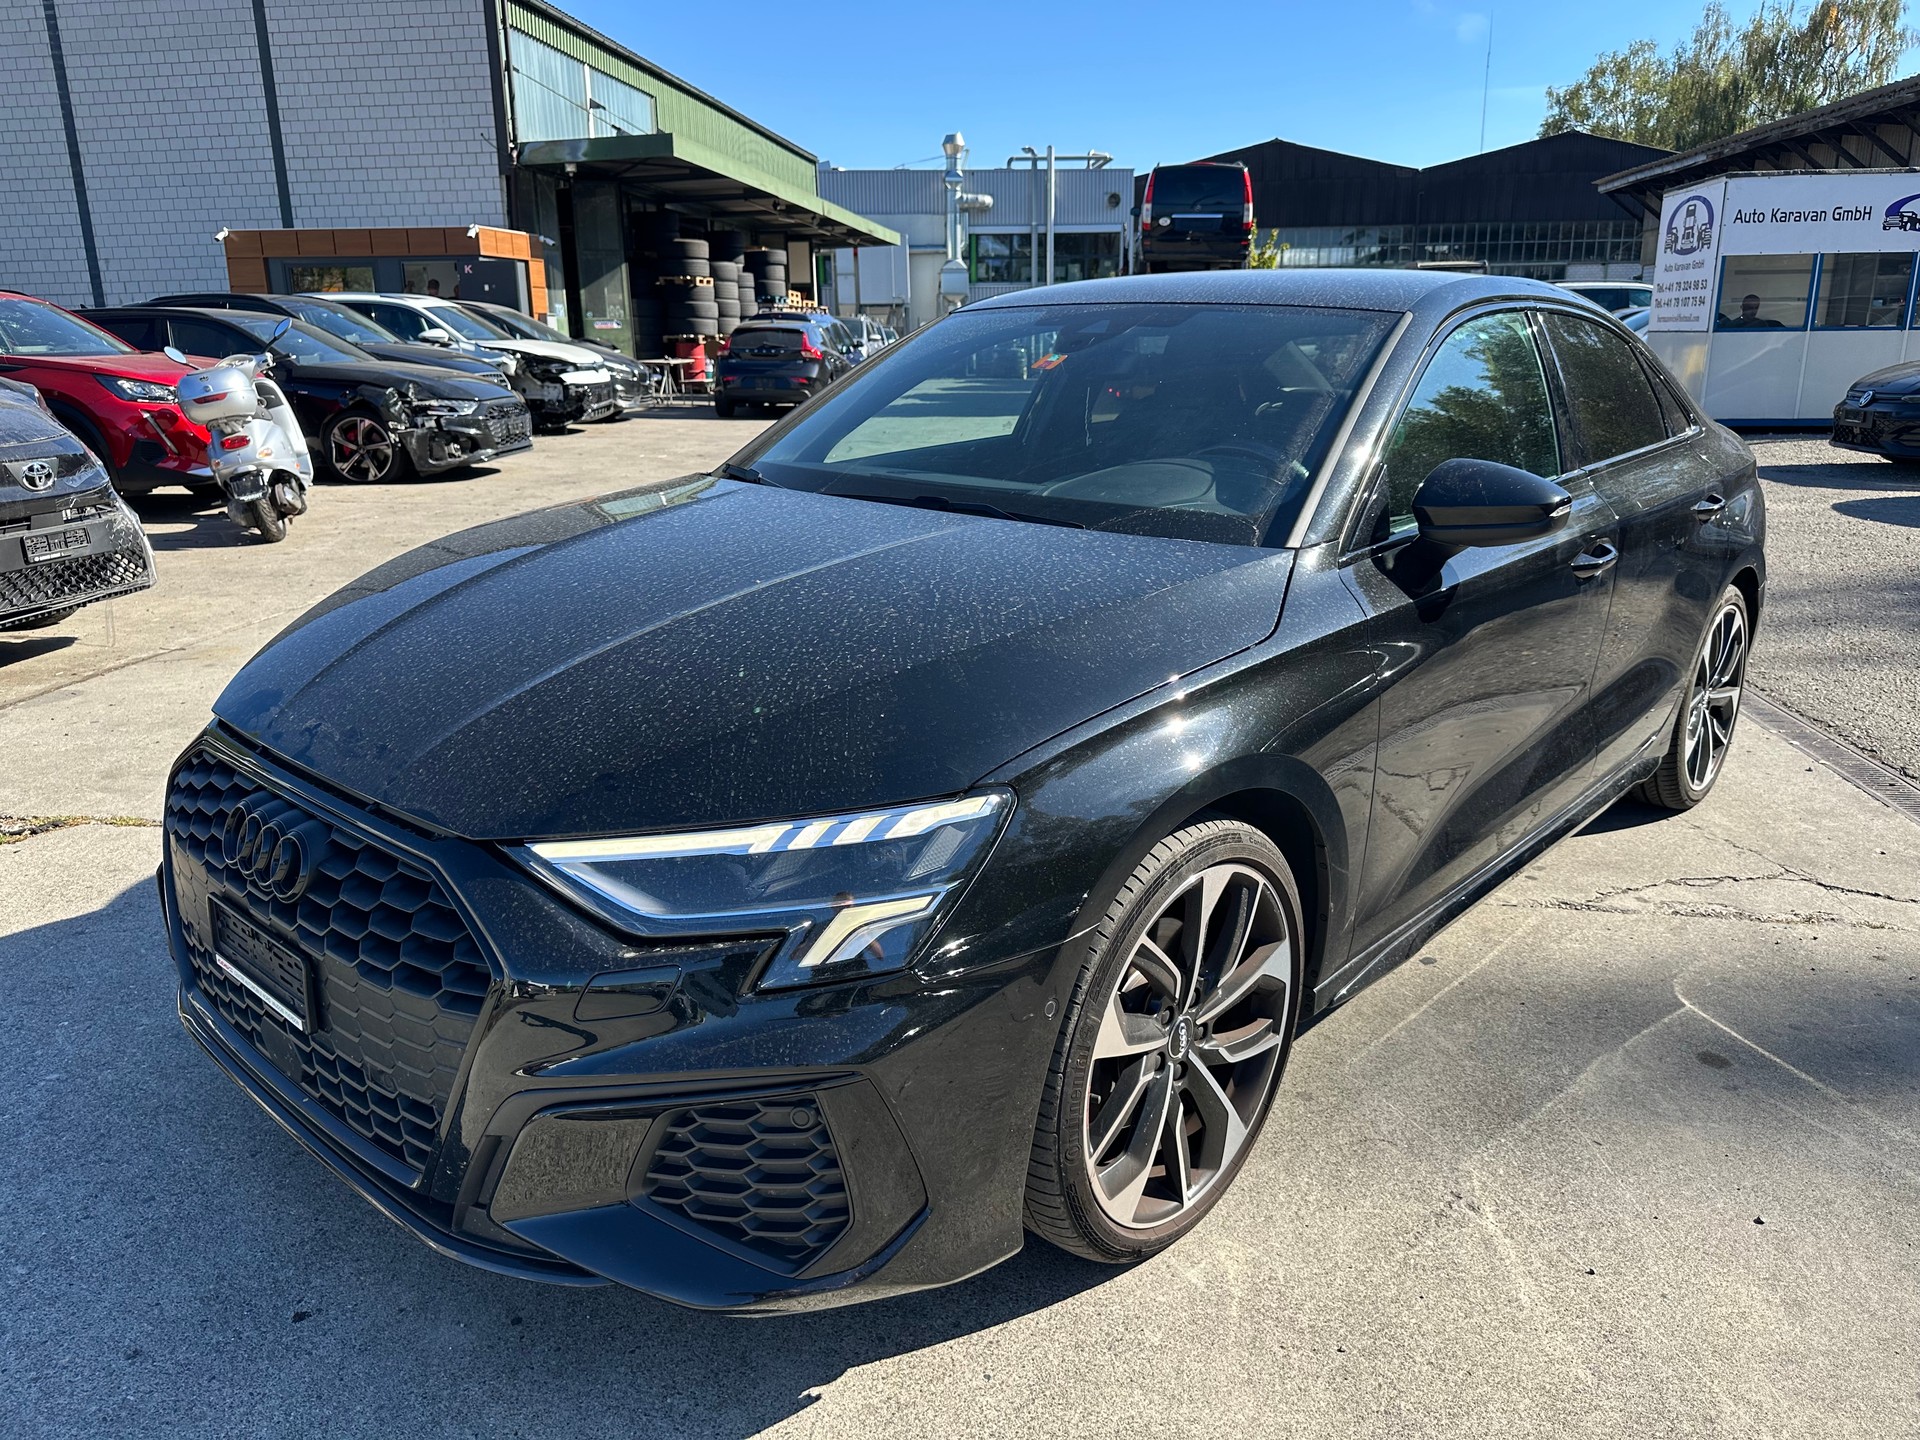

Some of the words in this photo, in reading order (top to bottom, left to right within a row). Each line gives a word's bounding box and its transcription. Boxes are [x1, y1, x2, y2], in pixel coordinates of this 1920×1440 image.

[1733, 208, 1766, 224] Auto
[1770, 207, 1828, 223] Karavan
[1832, 205, 1873, 221] GmbH
[464, 264, 473, 274] K
[1664, 264, 1673, 272] Auto
[1674, 262, 1691, 271] Karavan
[1692, 259, 1705, 269] GmbH
[1675, 281, 1682, 292] 79
[1682, 280, 1692, 291] 324
[1700, 279, 1708, 290] 53
[1698, 295, 1706, 306] 94
